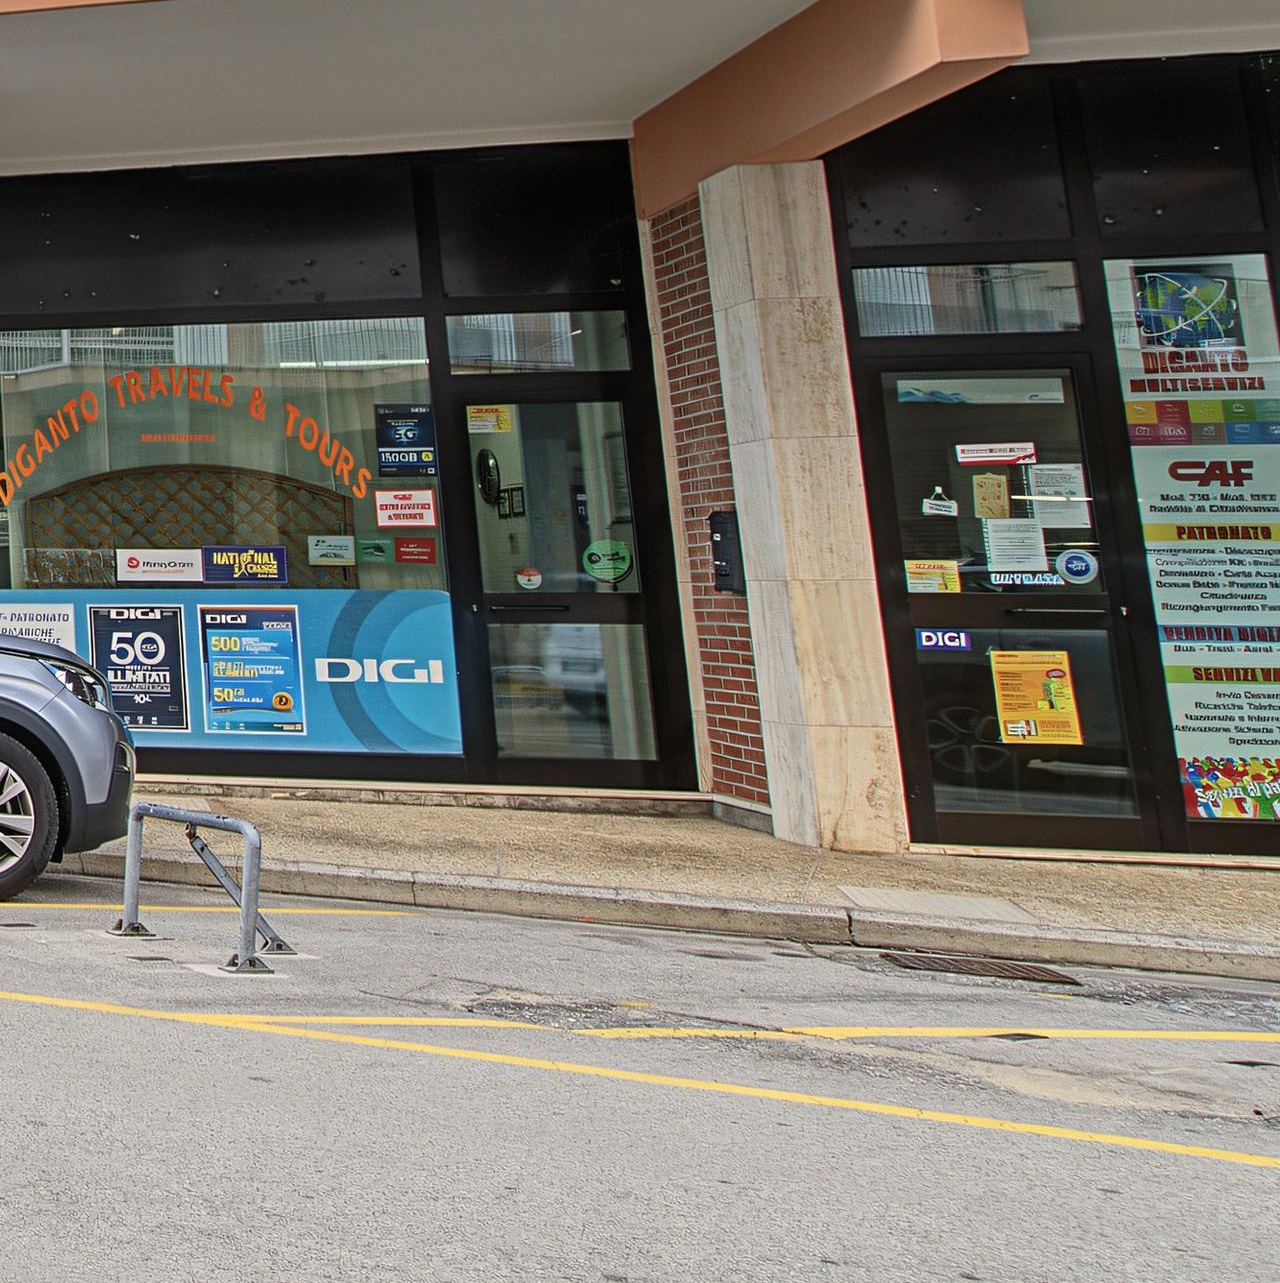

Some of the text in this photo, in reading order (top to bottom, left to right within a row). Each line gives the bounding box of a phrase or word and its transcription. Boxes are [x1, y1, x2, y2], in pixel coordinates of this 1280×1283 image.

[109, 366, 234, 408] TRAVELS
[248, 386, 266, 421] &
[284, 402, 372, 500] TOURS
[1167, 460, 1254, 487] CAF
[1176, 525, 1272, 540] PATRONATO
[109, 608, 162, 620] DIGI
[109, 631, 166, 666] 50
[920, 631, 967, 647] DIGI
[314, 658, 444, 684] DIGI
